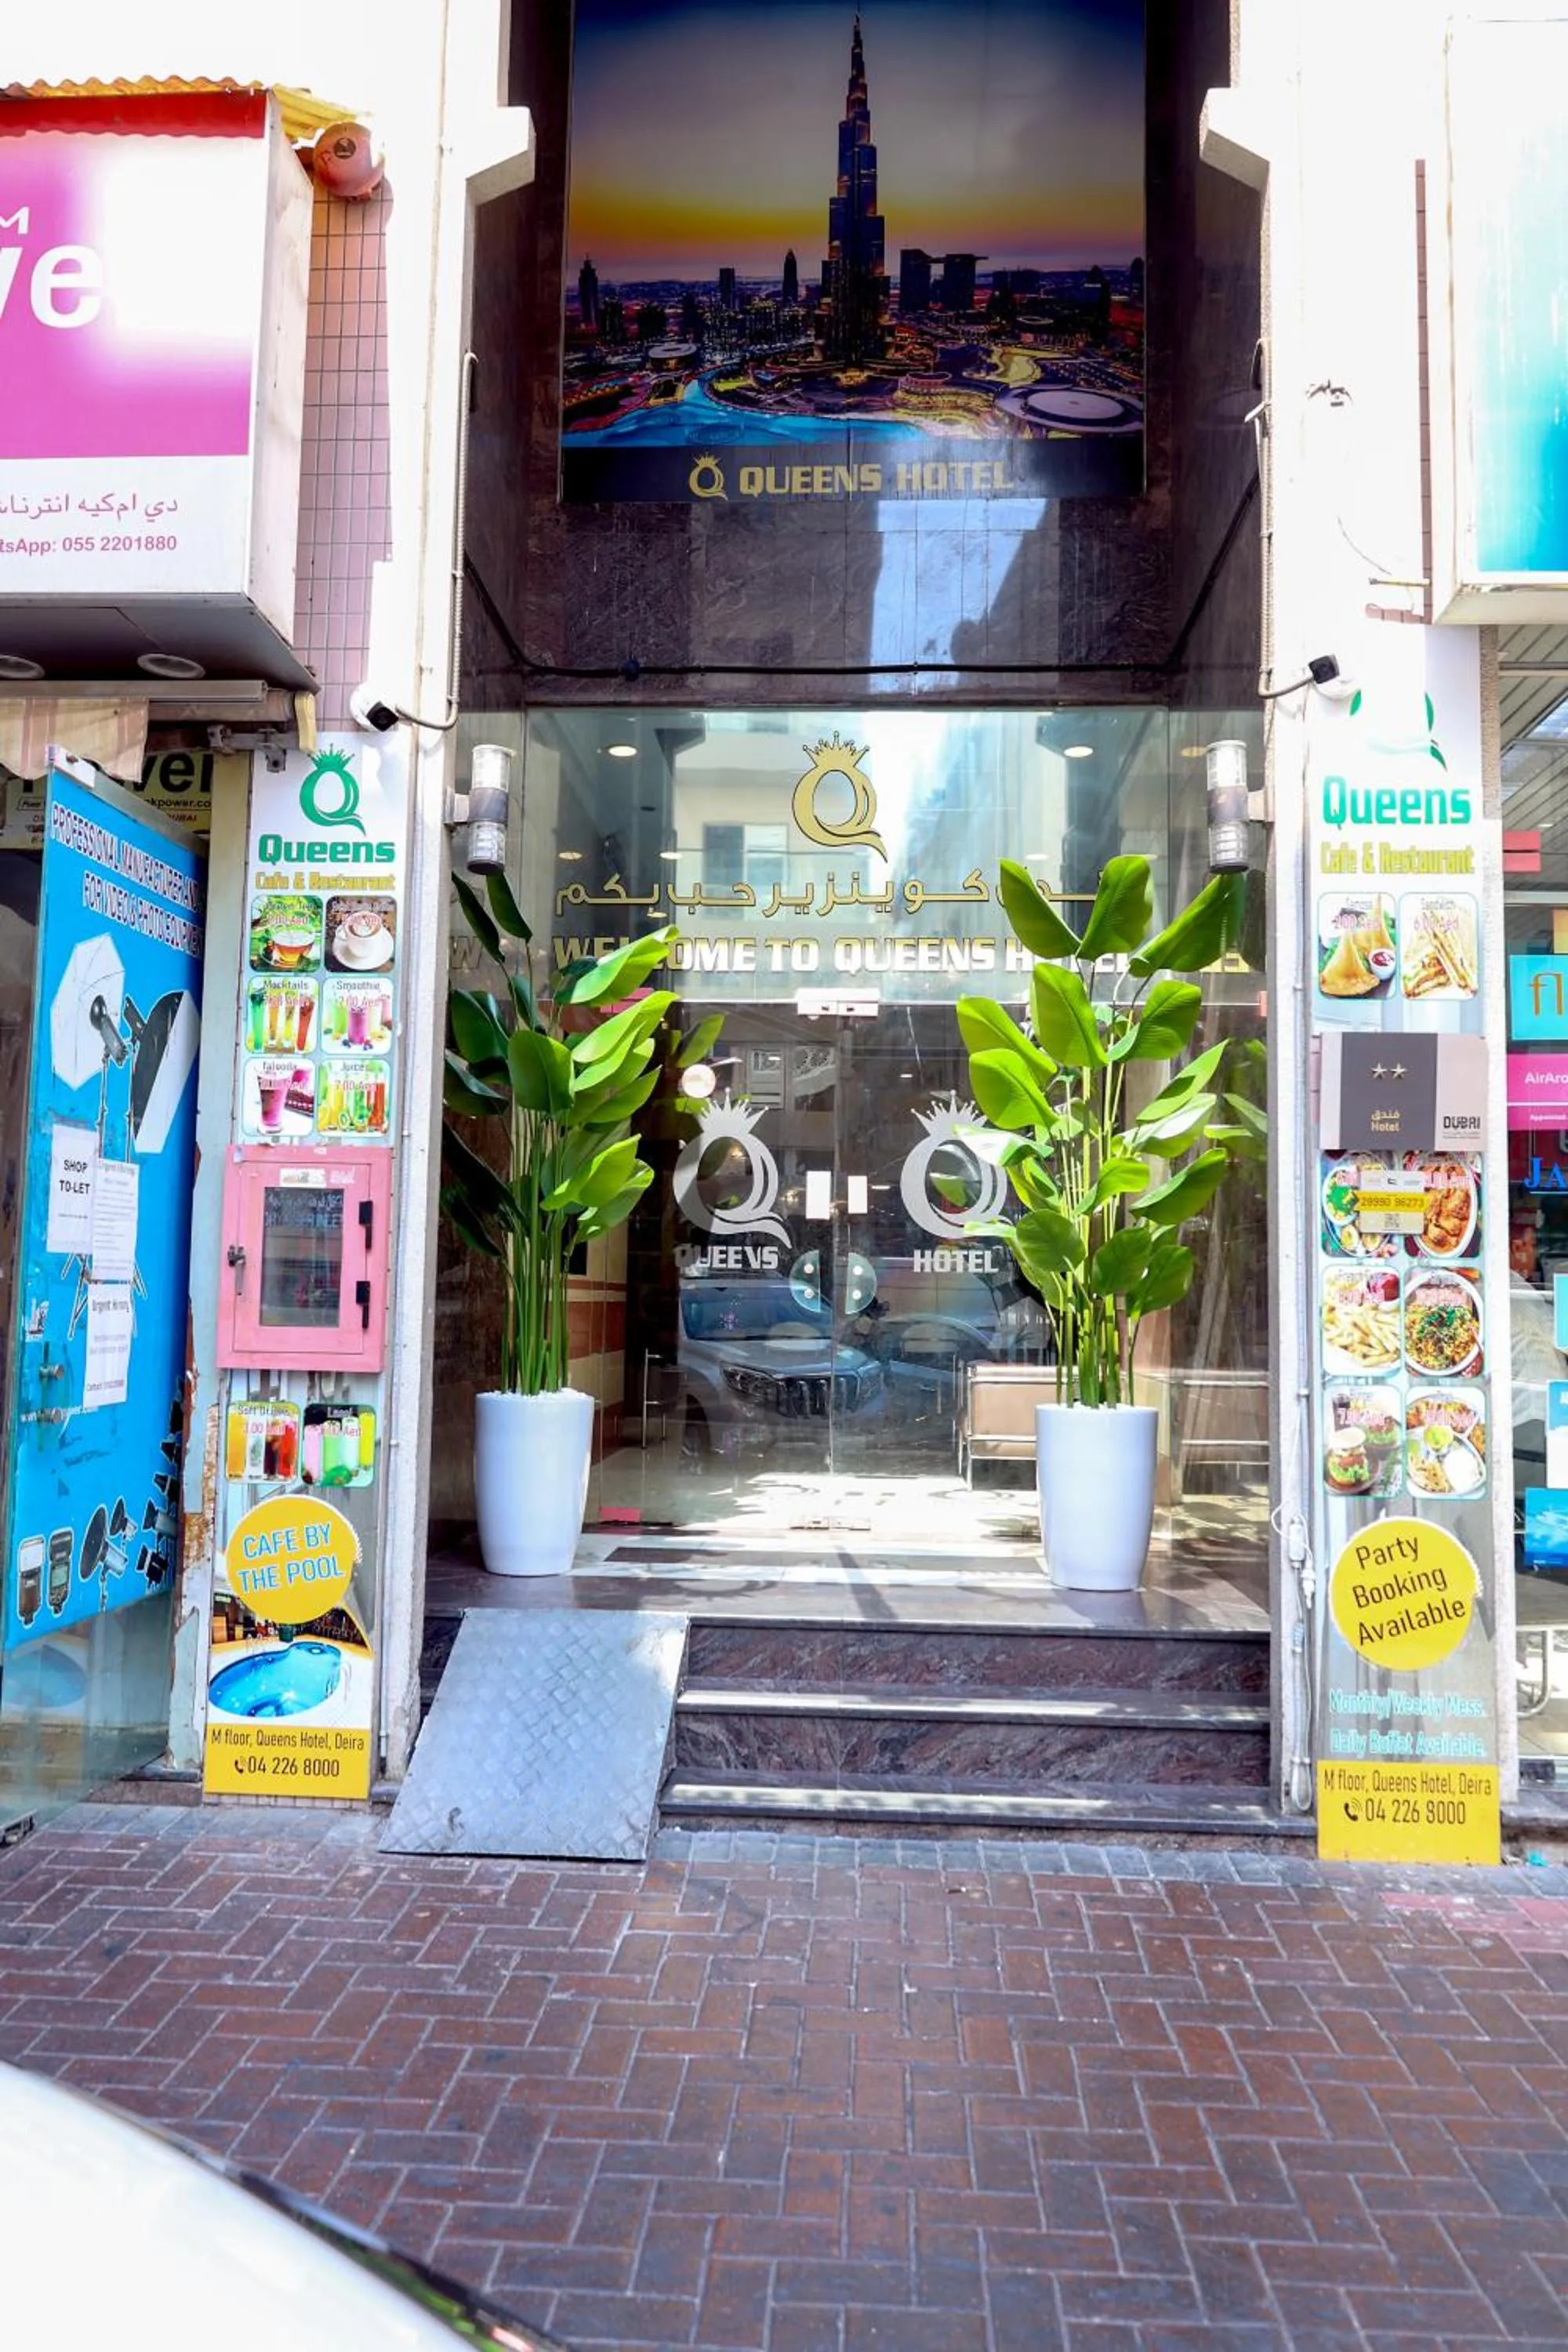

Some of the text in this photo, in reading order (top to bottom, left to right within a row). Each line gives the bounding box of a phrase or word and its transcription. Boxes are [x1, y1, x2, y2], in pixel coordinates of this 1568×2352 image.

[739, 463, 881, 498] QUEENS
[896, 461, 1014, 491] HOTEL
[62, 536, 95, 552] 055
[100, 535, 177, 552] 2201880
[1323, 775, 1472, 831] Queens
[51, 800, 118, 872] PROFESSIONAL
[258, 833, 396, 866] Queens
[1320, 840, 1475, 874] Cafe & Restaurant
[255, 871, 396, 891] Cafe & Restaurant
[552, 936, 1129, 975] WEOME TO QUEENS HEL
[1371, 1121, 1400, 1132] Hotel
[64, 1159, 88, 1174] SHOP
[913, 1249, 1000, 1273] HOTEL
[242, 1522, 332, 1559] CAFE BY
[1356, 1535, 1420, 1570] Party
[238, 1554, 345, 1594] THE POOL
[1352, 1567, 1448, 1609] Booking
[1358, 1595, 1467, 1646] Available
[211, 1729, 365, 1751] M floor, Queens Hotel, Deira
[246, 1755, 340, 1777] 04 226 8000
[1323, 1769, 1492, 1795] M floor, Queens Hotel, Deira
[1364, 1800, 1467, 1826] 04 226 8000
